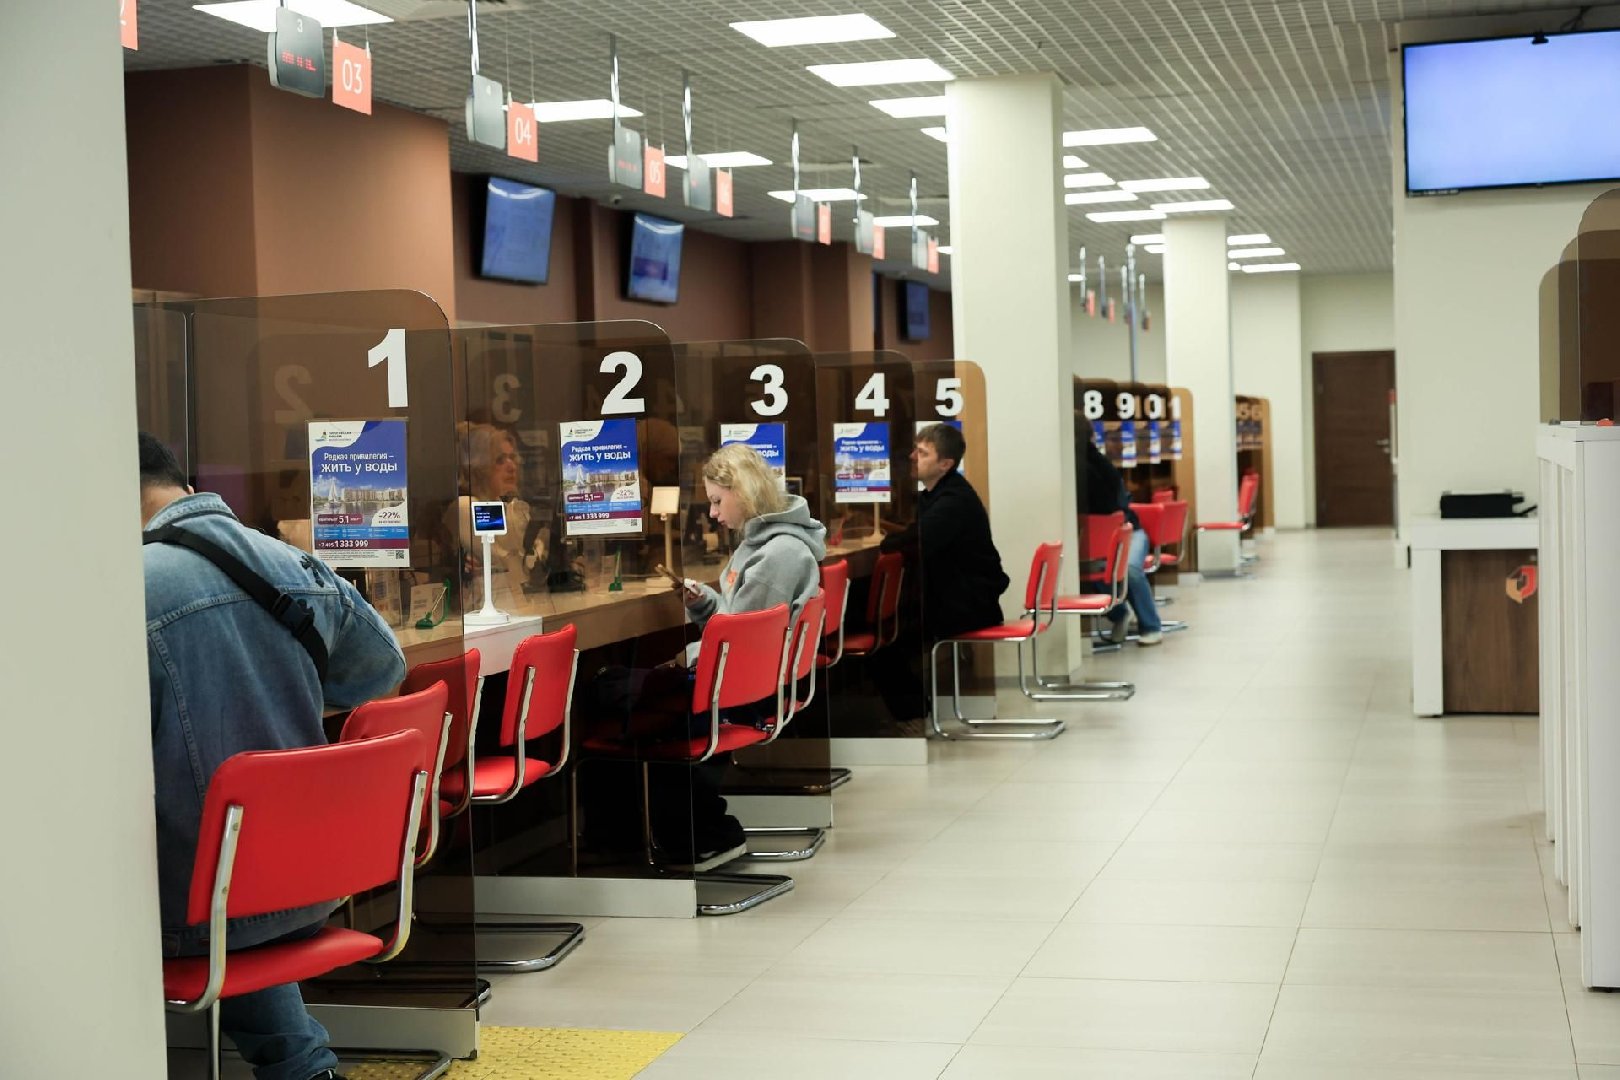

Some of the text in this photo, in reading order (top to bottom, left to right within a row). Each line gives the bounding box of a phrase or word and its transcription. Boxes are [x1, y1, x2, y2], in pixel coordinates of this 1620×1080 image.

[297, 18, 303, 33] 3
[342, 58, 363, 94] 03
[514, 117, 532, 145] 04
[367, 328, 409, 408] 1
[599, 351, 645, 415] 2
[750, 364, 788, 416] 3
[855, 372, 889, 417] 4
[935, 377, 964, 416] 5
[1084, 390, 1104, 420] 8
[1116, 392, 1135, 419] 9
[324, 452, 348, 461] Редкая
